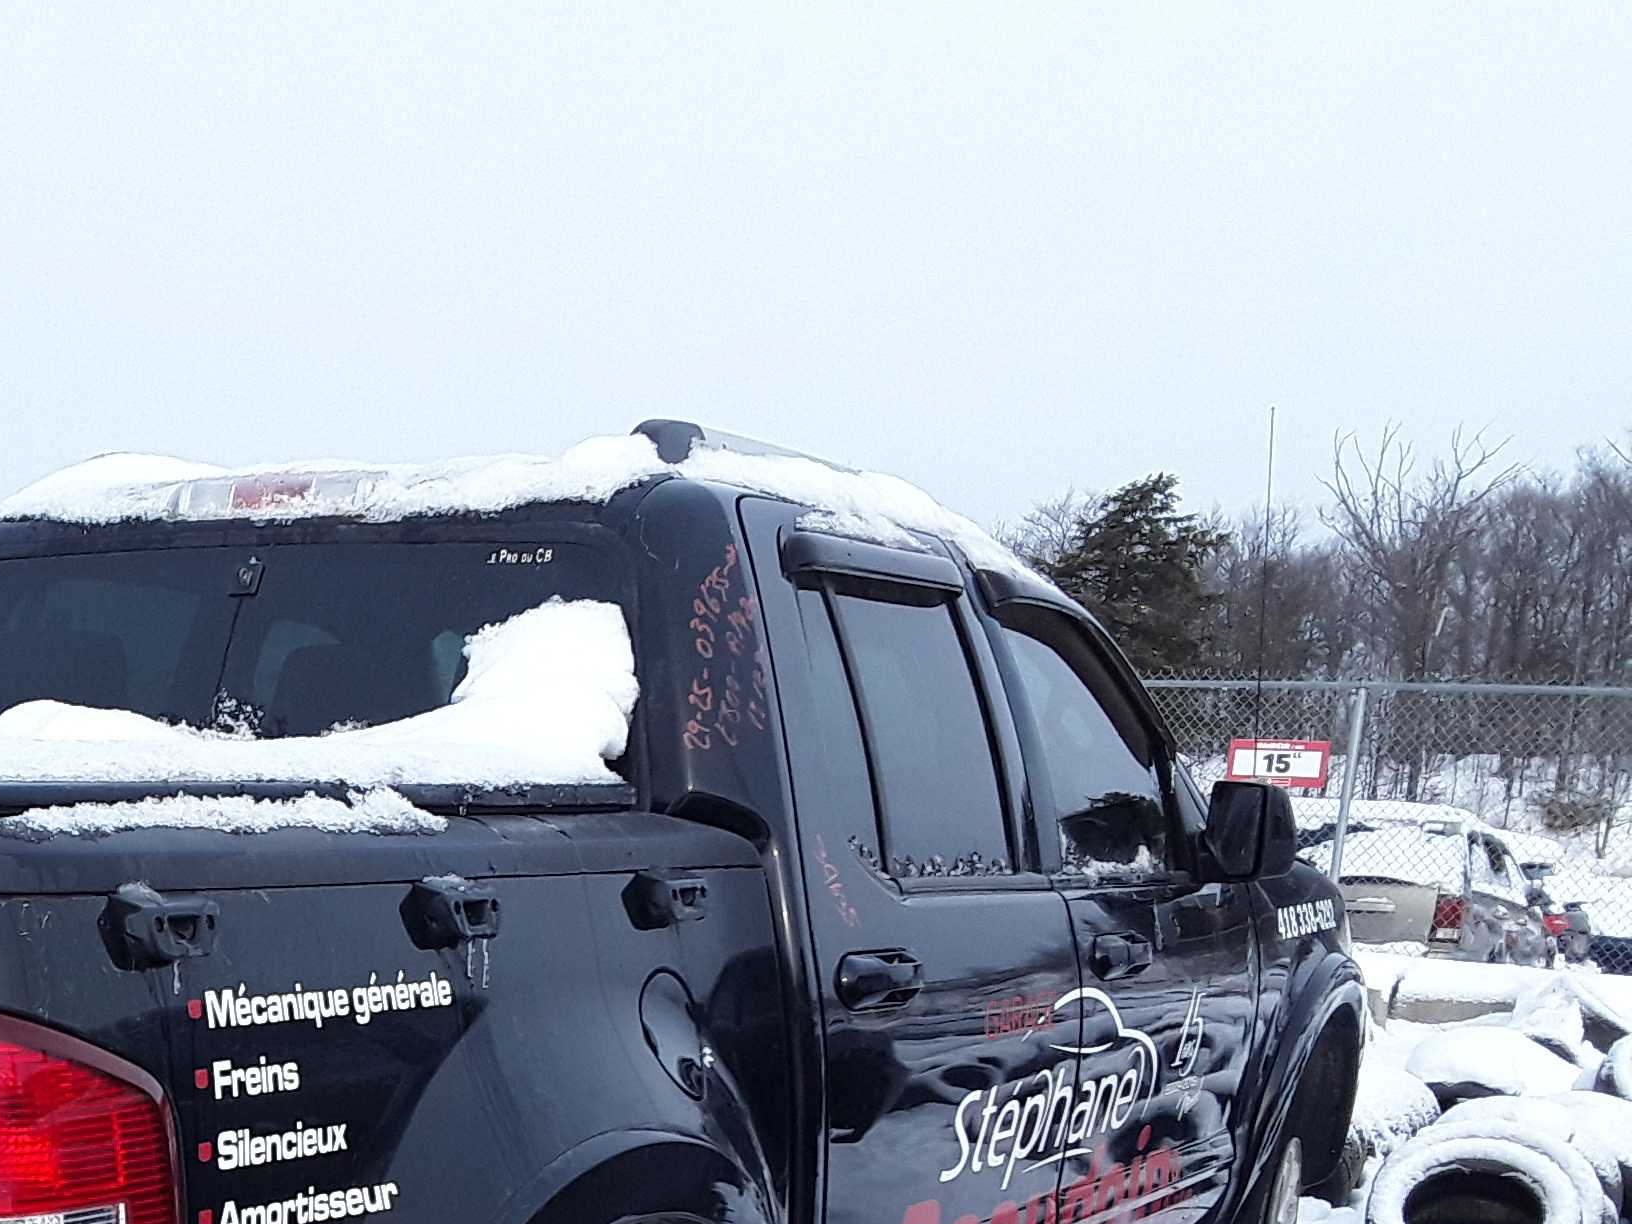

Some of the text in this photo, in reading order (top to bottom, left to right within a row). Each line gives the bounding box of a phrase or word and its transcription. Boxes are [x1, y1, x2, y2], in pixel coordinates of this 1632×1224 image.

[536, 548, 553, 563] CB
[1278, 906, 1298, 939] 418
[205, 970, 452, 1029] Mécanique générale
[1171, 986, 1206, 1077] 15
[212, 1056, 299, 1099] Freins
[940, 1046, 1144, 1190] Stéphane
[217, 1121, 348, 1171] Silencieux
